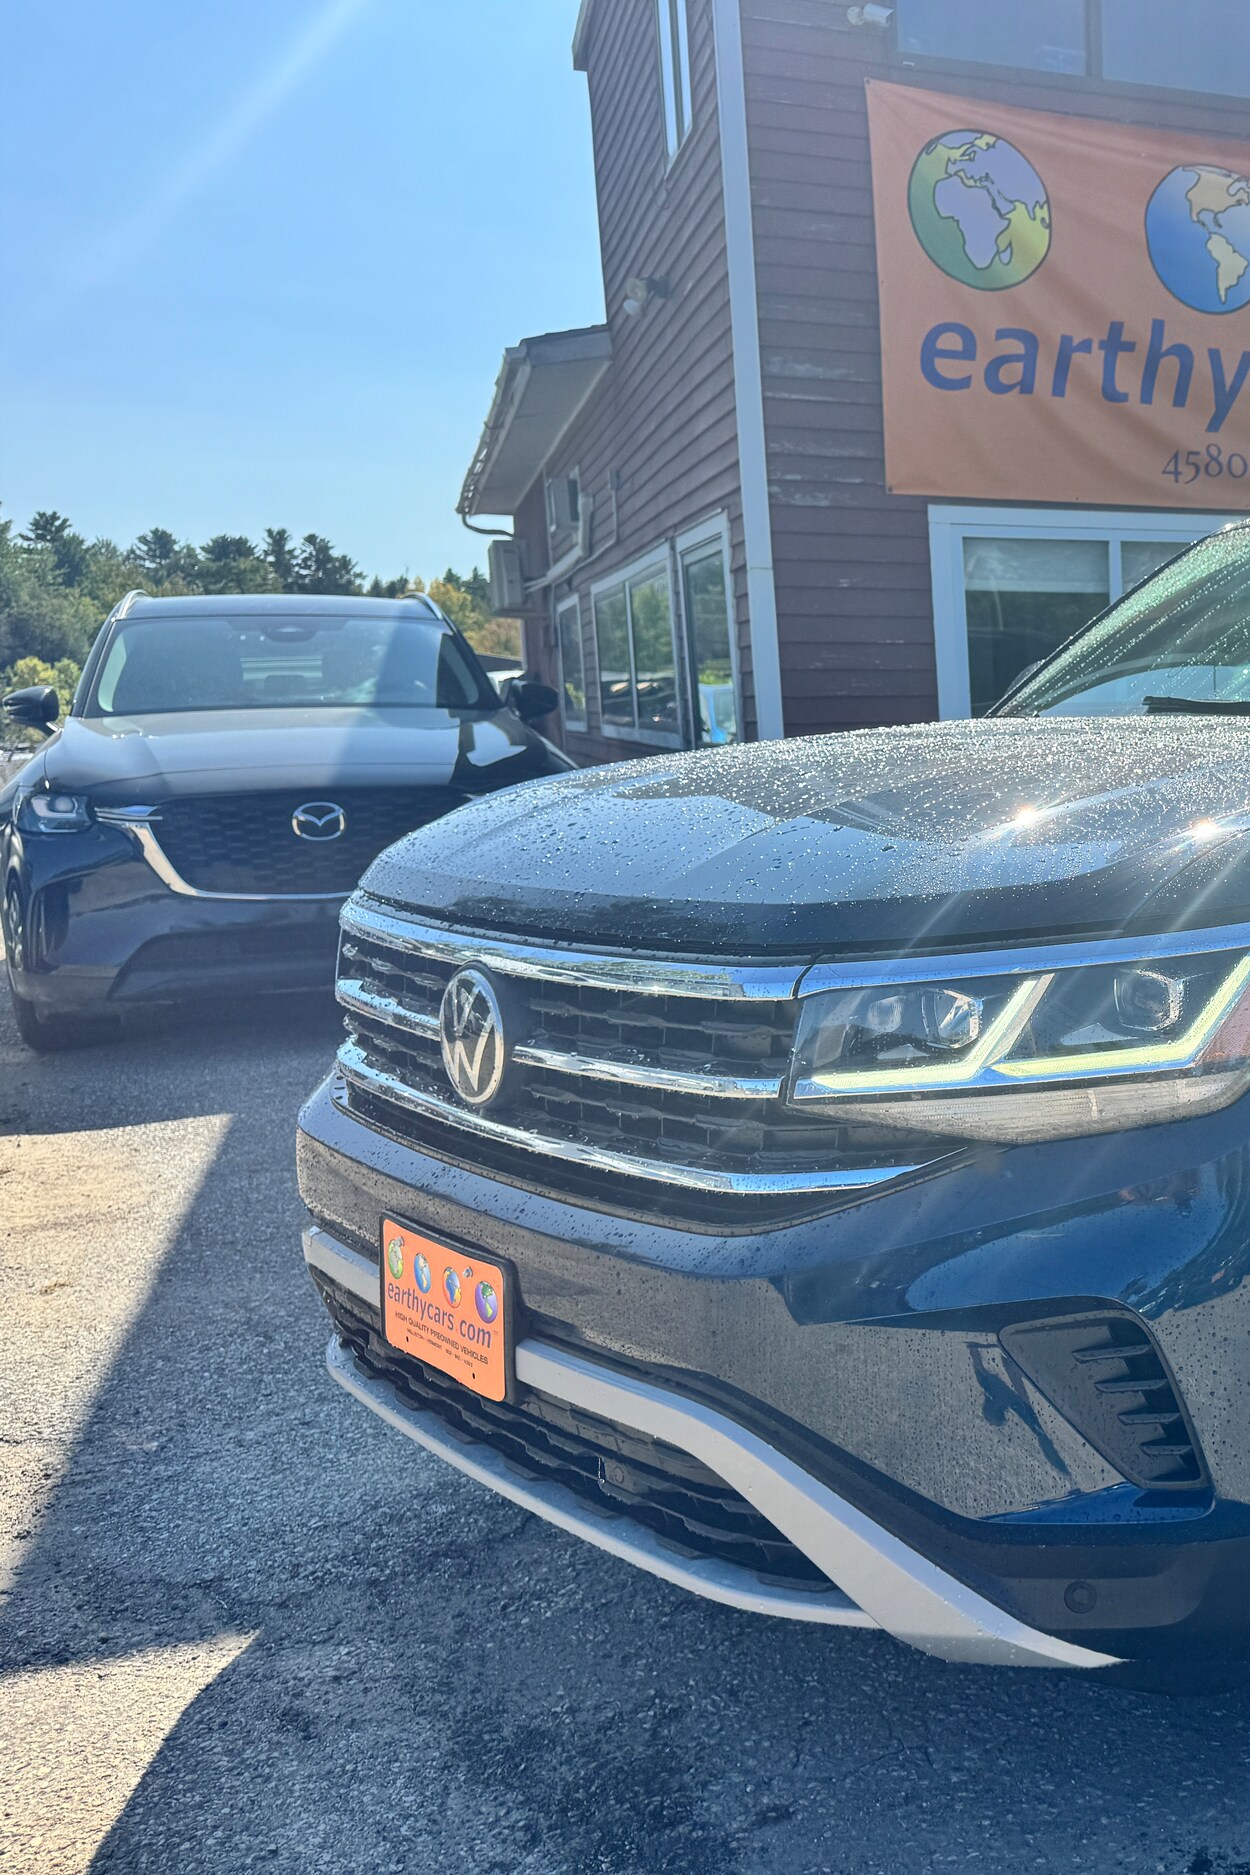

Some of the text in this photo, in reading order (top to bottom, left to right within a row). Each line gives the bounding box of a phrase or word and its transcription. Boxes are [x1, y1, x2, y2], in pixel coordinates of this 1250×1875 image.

[1161, 443, 1248, 484] 4580
[395, 1311, 407, 1323] HIGH
[408, 1317, 429, 1334] QUALITY
[460, 1344, 489, 1366] VEHICLES
